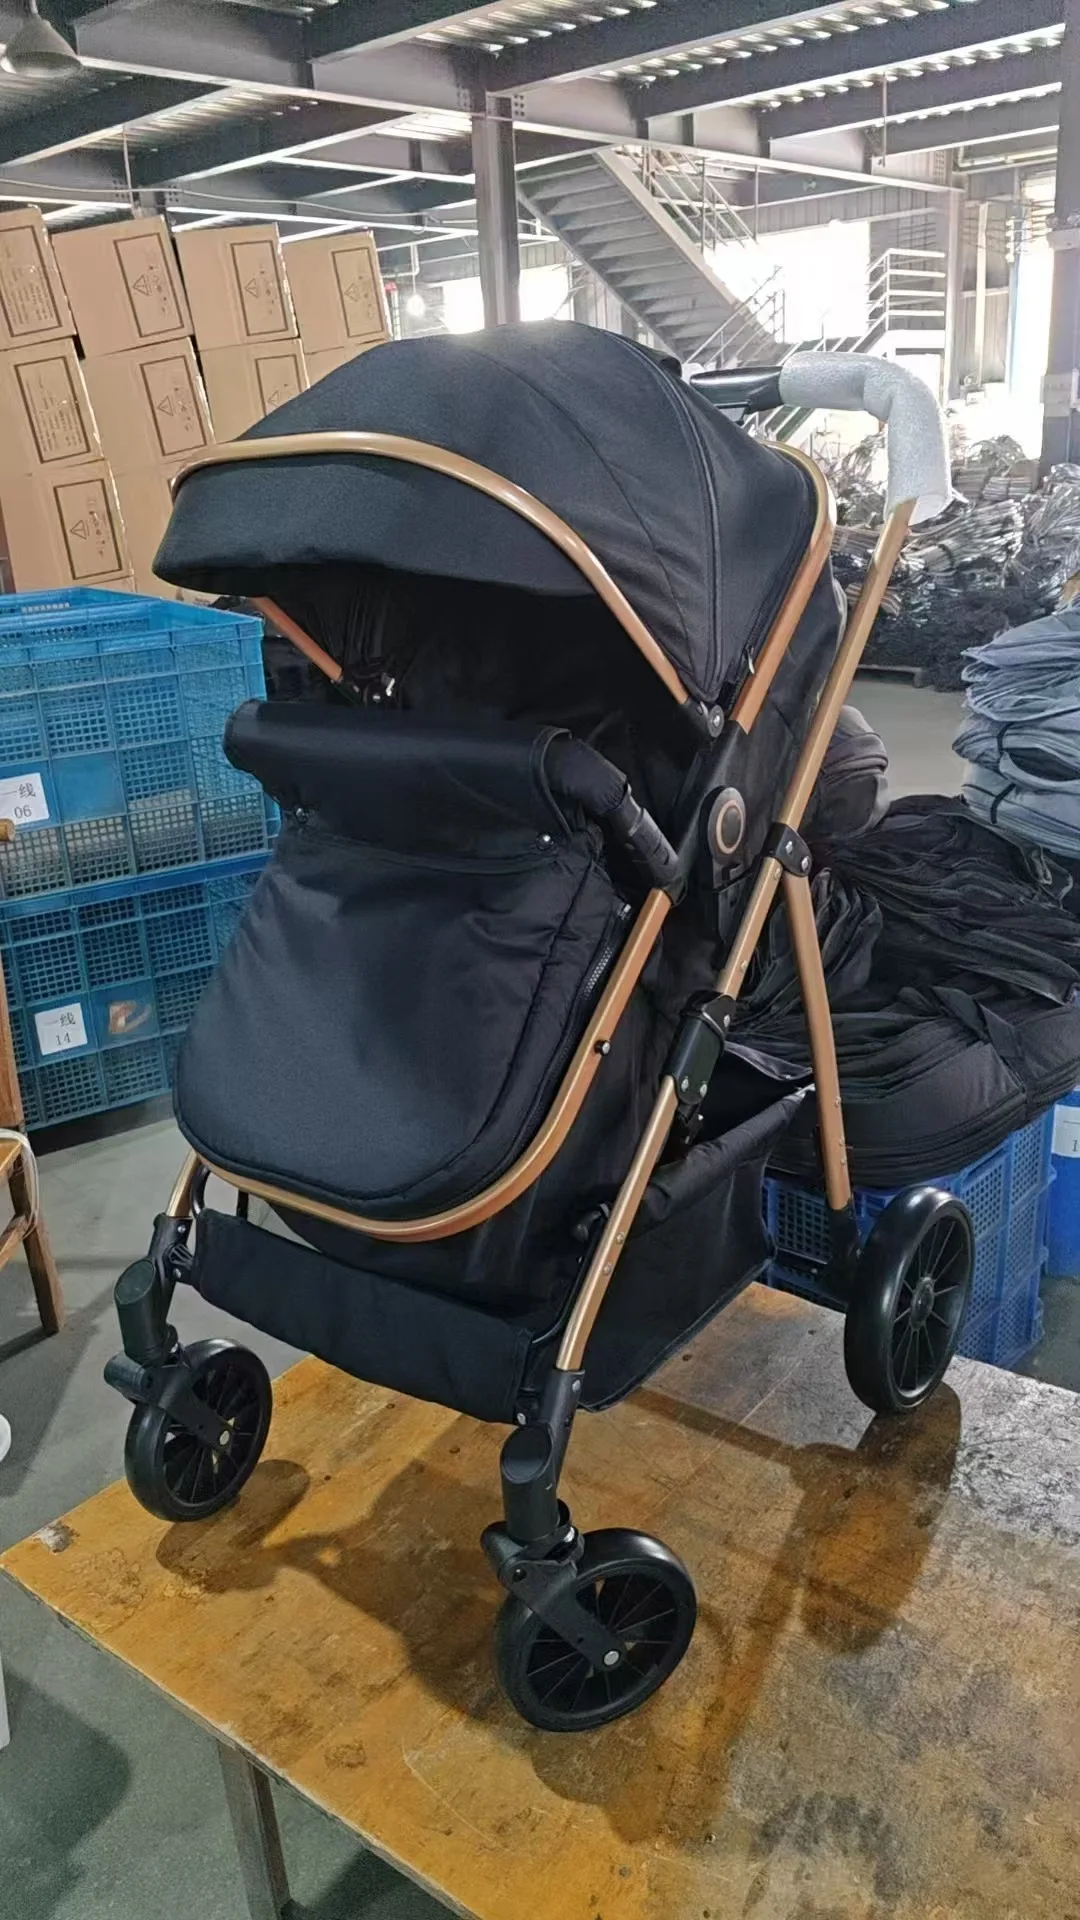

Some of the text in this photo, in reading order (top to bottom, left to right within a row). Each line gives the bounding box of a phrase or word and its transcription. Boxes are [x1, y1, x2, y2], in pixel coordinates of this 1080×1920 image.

[14, 804, 32, 819] 06
[43, 1011, 76, 1027] 一线
[56, 1032, 71, 1046] 14
